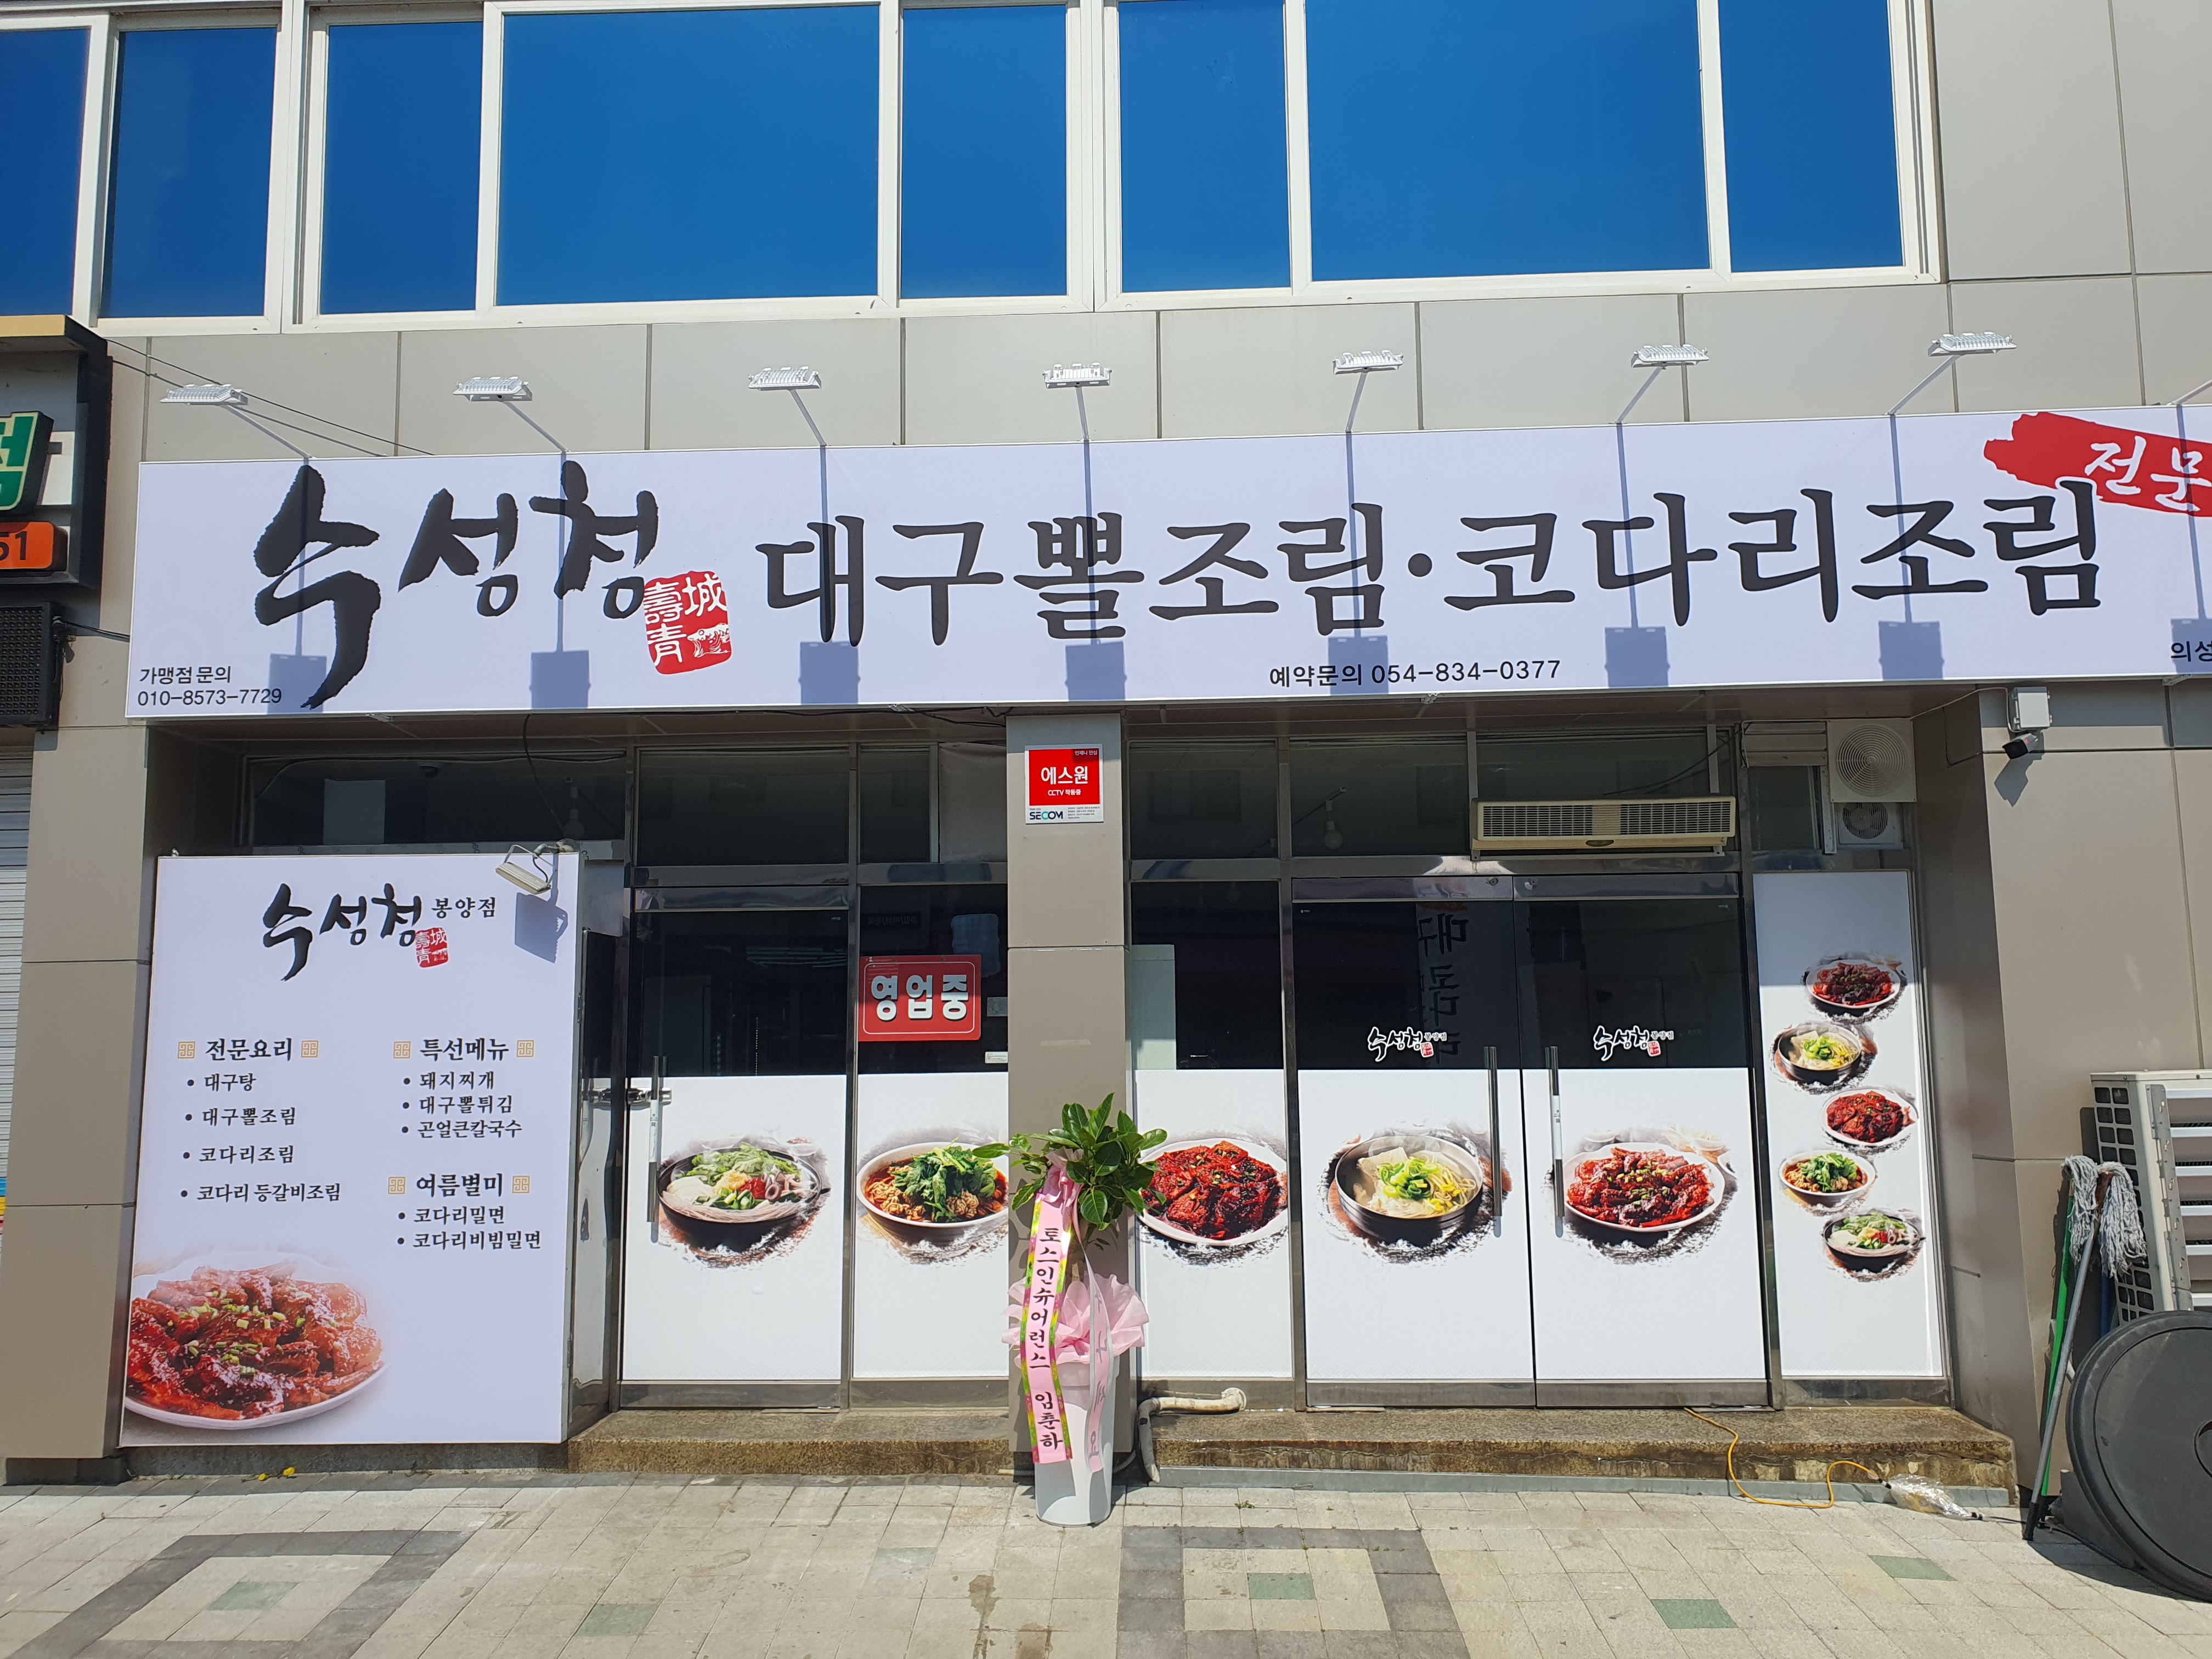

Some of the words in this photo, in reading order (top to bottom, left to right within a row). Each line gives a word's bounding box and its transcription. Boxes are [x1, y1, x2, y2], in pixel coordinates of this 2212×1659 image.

[2085, 436, 2212, 511] 전문
[253, 460, 659, 710] 수성청
[139, 667, 192, 685] 가맹점
[196, 665, 231, 684] 문의
[1269, 664, 1362, 688] 예약문의
[1372, 660, 1561, 684] 054-834-0377
[138, 689, 282, 706] 010-8573-7729
[1041, 766, 1088, 785] 에스원
[1029, 811, 1063, 820] SECOM
[263, 883, 422, 981] 수성청
[431, 896, 497, 919] 봉양점
[871, 974, 969, 1021] 영업중
[205, 1037, 292, 1062] 전문요리
[420, 1037, 509, 1062] 특선메뉴
[1367, 1026, 1423, 1062] 수성청
[1593, 1025, 1650, 1062] 수성청
[205, 1073, 256, 1092] 대구탕
[419, 1071, 494, 1090] 돼지찌개
[419, 1095, 512, 1115] 대구뽈튀김
[202, 1107, 296, 1126] 대구뽈조림
[417, 1119, 523, 1138] 곤얼큰칼국수
[199, 1145, 294, 1165] 코다리조림
[196, 1183, 249, 1203] 코다리
[253, 1183, 341, 1203] 등갈비조림
[416, 1173, 503, 1198] 여름별미
[413, 1205, 504, 1225] 코다리밀면
[412, 1231, 541, 1250] 코다리비빔밀면
[1028, 1228, 1061, 1369] 토스인슈어런스
[1035, 1391, 1063, 1450] 임춘하
